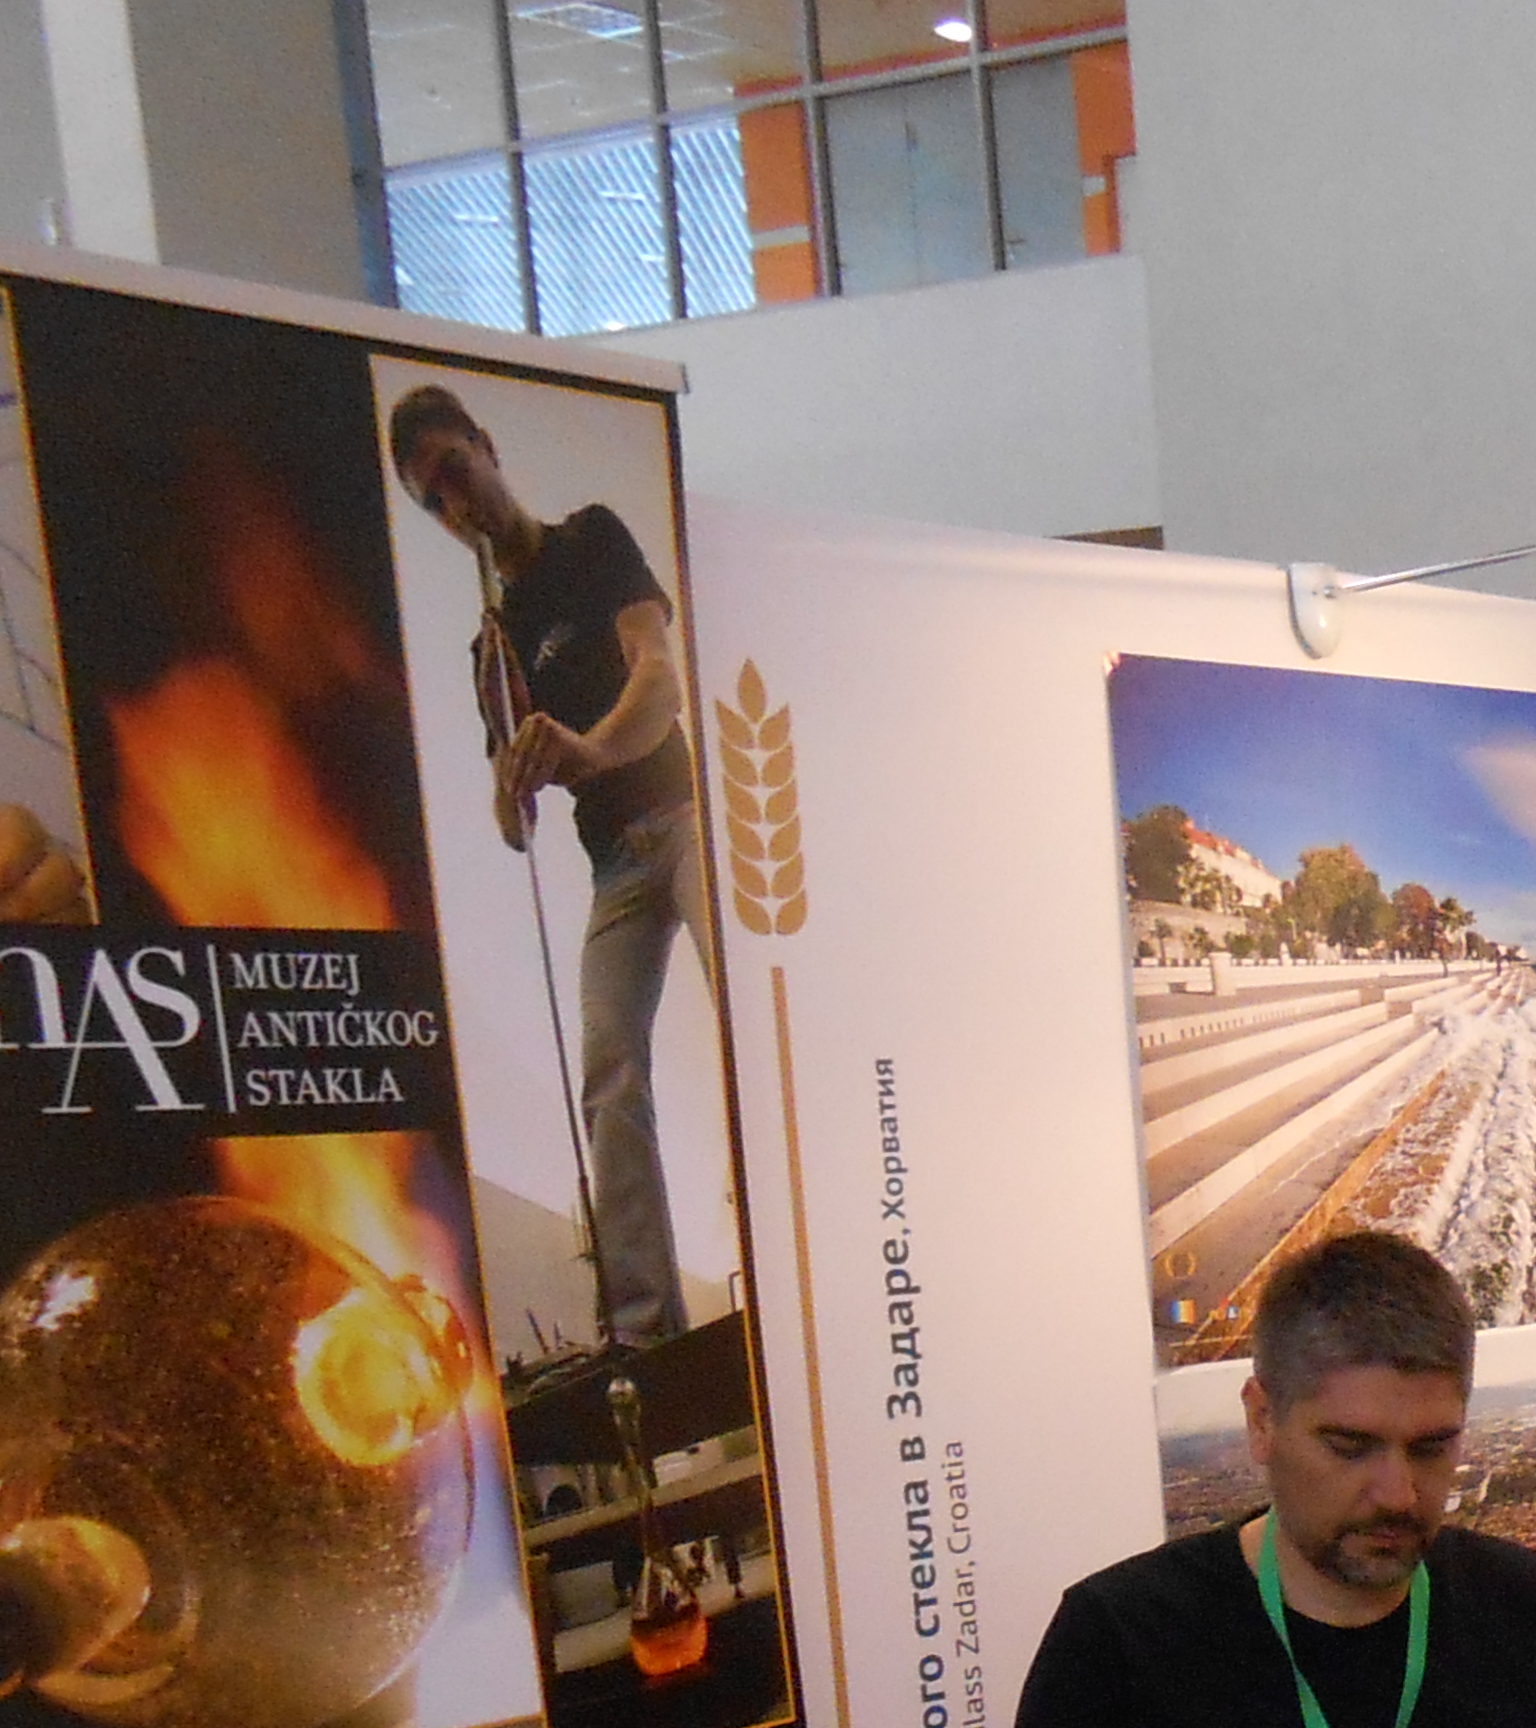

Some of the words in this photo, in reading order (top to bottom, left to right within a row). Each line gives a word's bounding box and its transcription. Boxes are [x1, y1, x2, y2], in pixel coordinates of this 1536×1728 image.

[230, 953, 361, 995] MUZEJ
[238, 1004, 438, 1049] ANTIČKOG
[246, 1068, 404, 1107] STAKLA
[875, 1058, 907, 1220] Хорватия
[882, 1227, 922, 1420] Задаре,
[899, 1435, 927, 1463] в
[940, 1440, 971, 1555] Croatia
[903, 1479, 941, 1638] стекла
[953, 1561, 981, 1657] Zadar,
